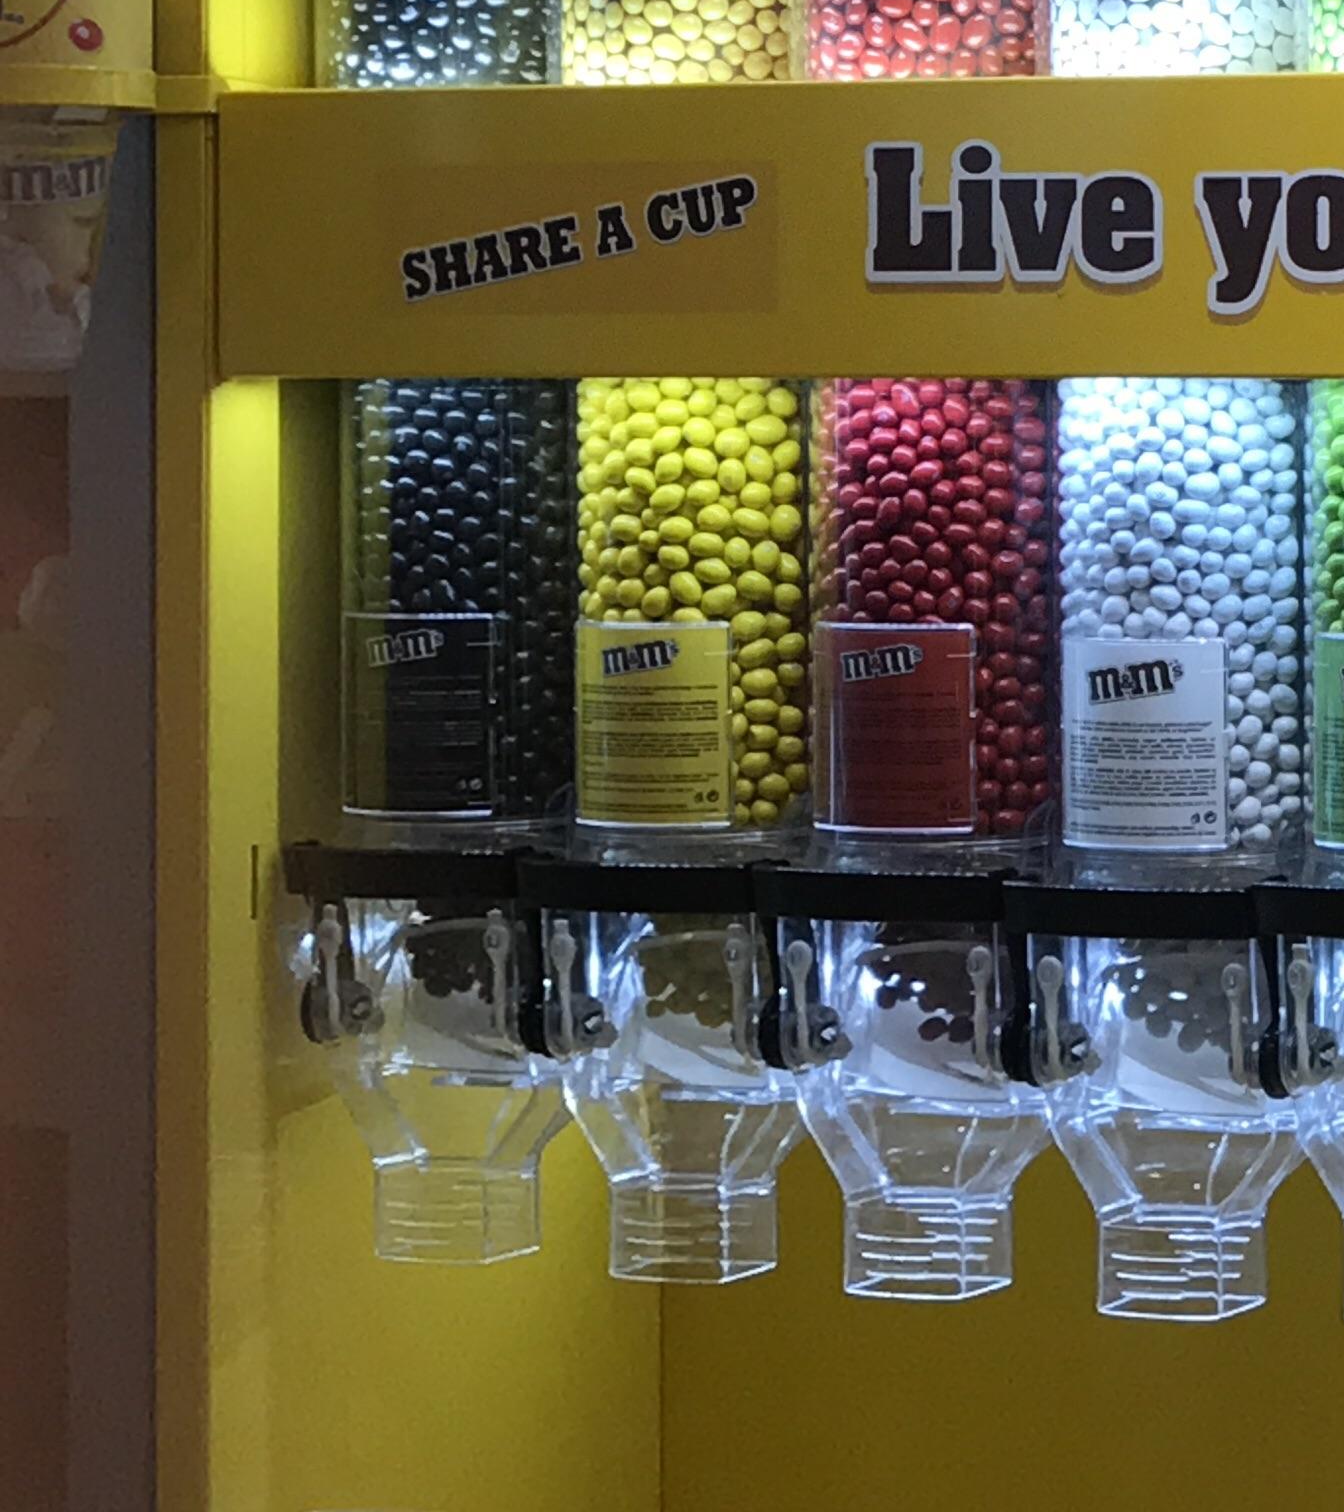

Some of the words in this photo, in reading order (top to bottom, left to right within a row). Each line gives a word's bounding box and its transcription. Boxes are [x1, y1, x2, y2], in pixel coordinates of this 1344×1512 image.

[402, 216, 581, 300] SHARE
[597, 205, 635, 255] A
[647, 177, 755, 241] CUP
[869, 141, 1158, 274] Live
